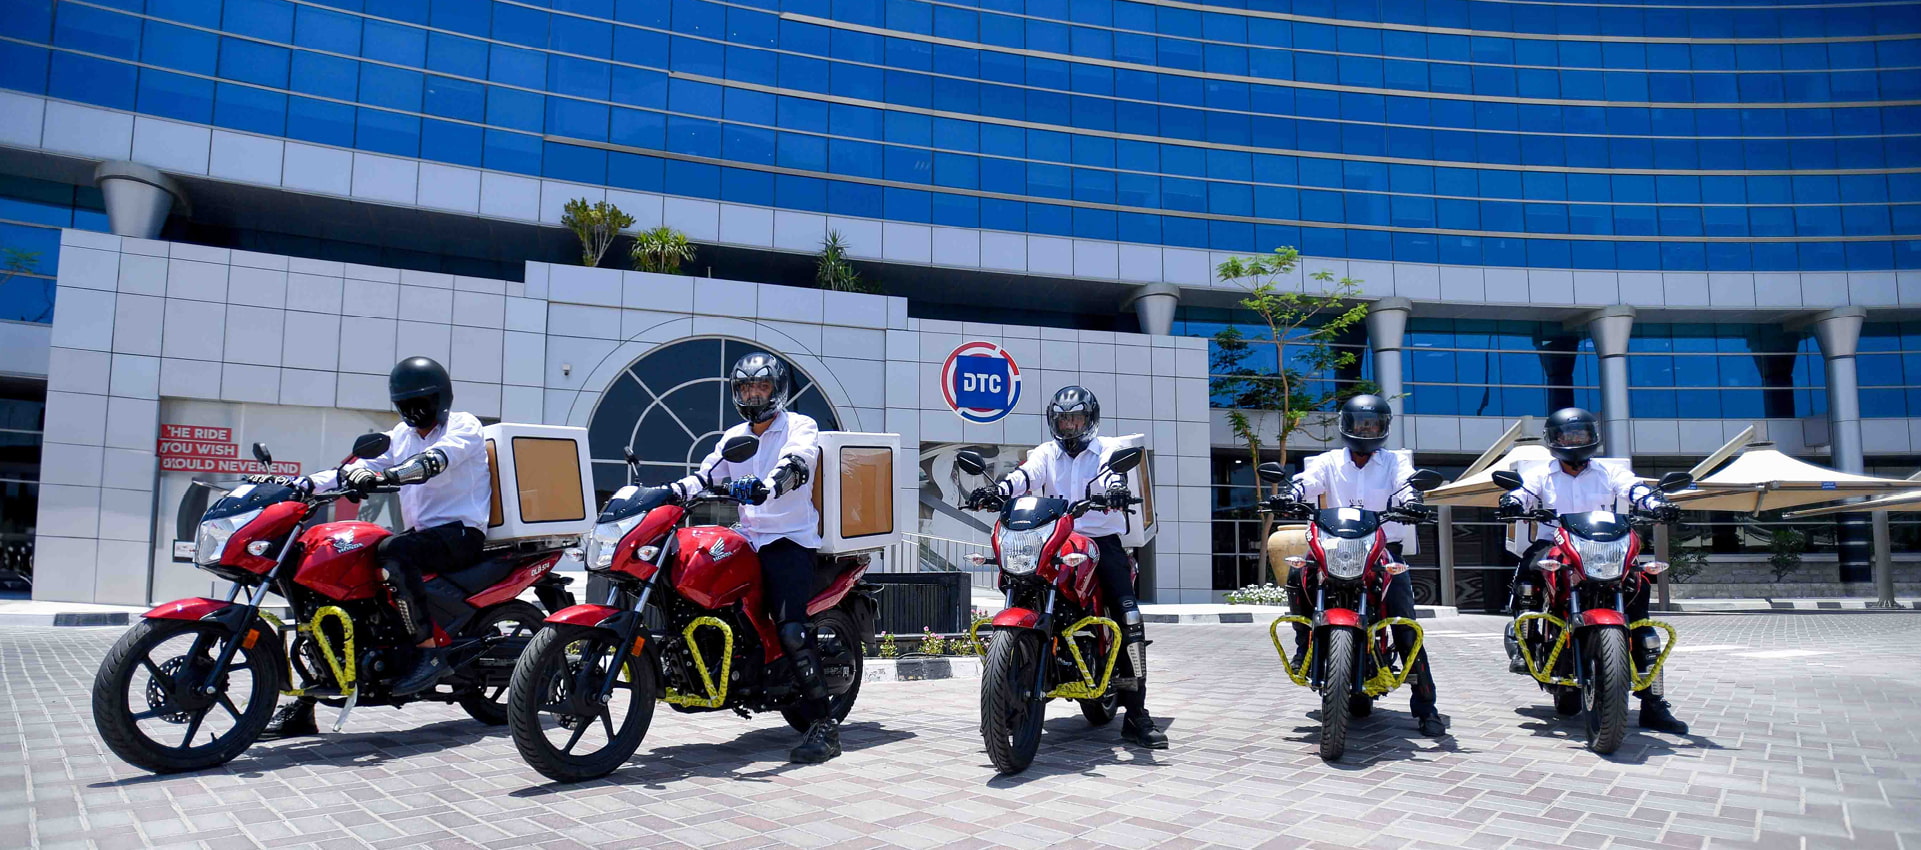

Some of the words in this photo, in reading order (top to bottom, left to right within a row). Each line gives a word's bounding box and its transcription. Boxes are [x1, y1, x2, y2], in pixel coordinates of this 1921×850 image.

[963, 372, 1002, 394] DTC
[167, 426, 191, 438] HE
[194, 428, 228, 440] RIDE
[196, 443, 236, 456] WISH
[218, 460, 267, 473] NEVER
[270, 461, 299, 474] END
[337, 542, 364, 553] HONDA
[712, 551, 733, 562] HONDA
